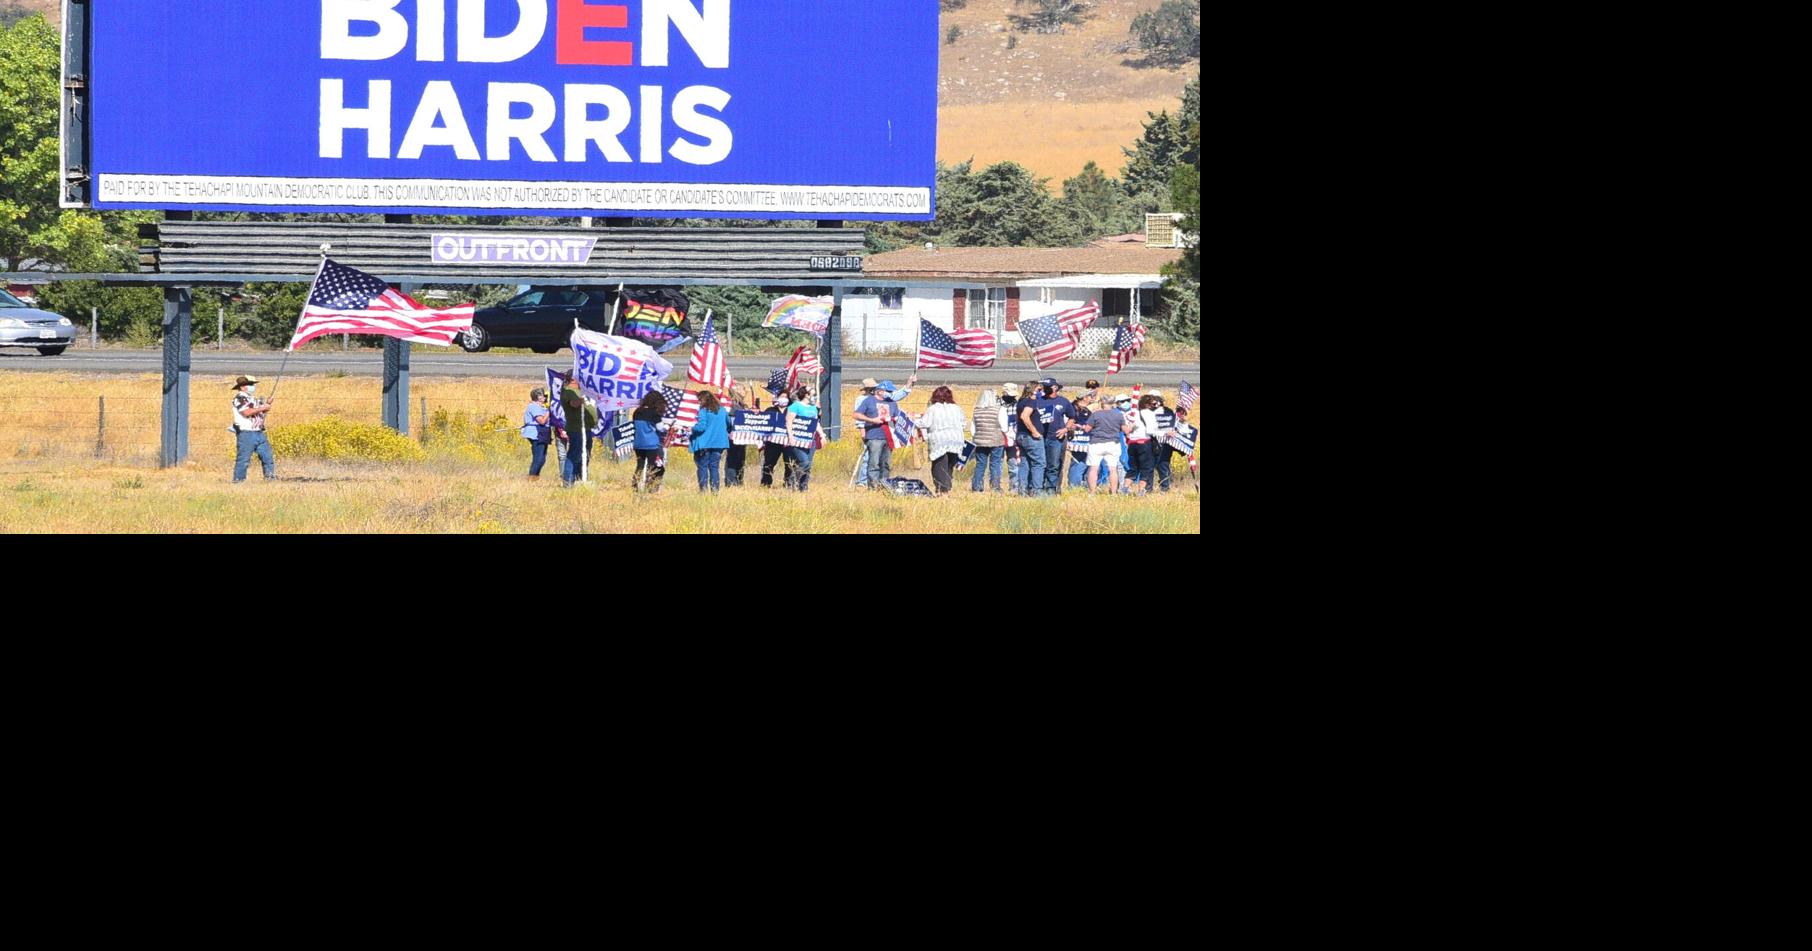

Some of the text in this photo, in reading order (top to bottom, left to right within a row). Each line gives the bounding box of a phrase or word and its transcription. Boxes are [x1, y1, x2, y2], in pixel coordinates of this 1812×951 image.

[320, 0, 730, 68] BIDEN
[318, 78, 734, 165] HARRIS
[104, 180, 125, 195] PAID
[128, 181, 146, 195] FOR
[149, 181, 161, 196] BY
[162, 181, 181, 196] THE
[182, 182, 234, 196] TEHACHAPI
[236, 183, 283, 198] MOUNTAIN
[284, 184, 343, 198] DEMOCRATIC
[373, 185, 393, 200] THIS
[395, 185, 469, 201] COMMUNICATION
[471, 187, 491, 201] WAS
[494, 187, 513, 201] NOT
[514, 187, 570, 202] AUTHORIZED
[571, 188, 583, 202] BY
[585, 188, 602, 203] THE
[603, 189, 652, 204] CANDIDATE
[654, 189, 667, 204] OR
[669, 189, 724, 205] CANDIDATE'S
[437, 237, 588, 261] OUTFRONT
[623, 299, 685, 326] DEN
